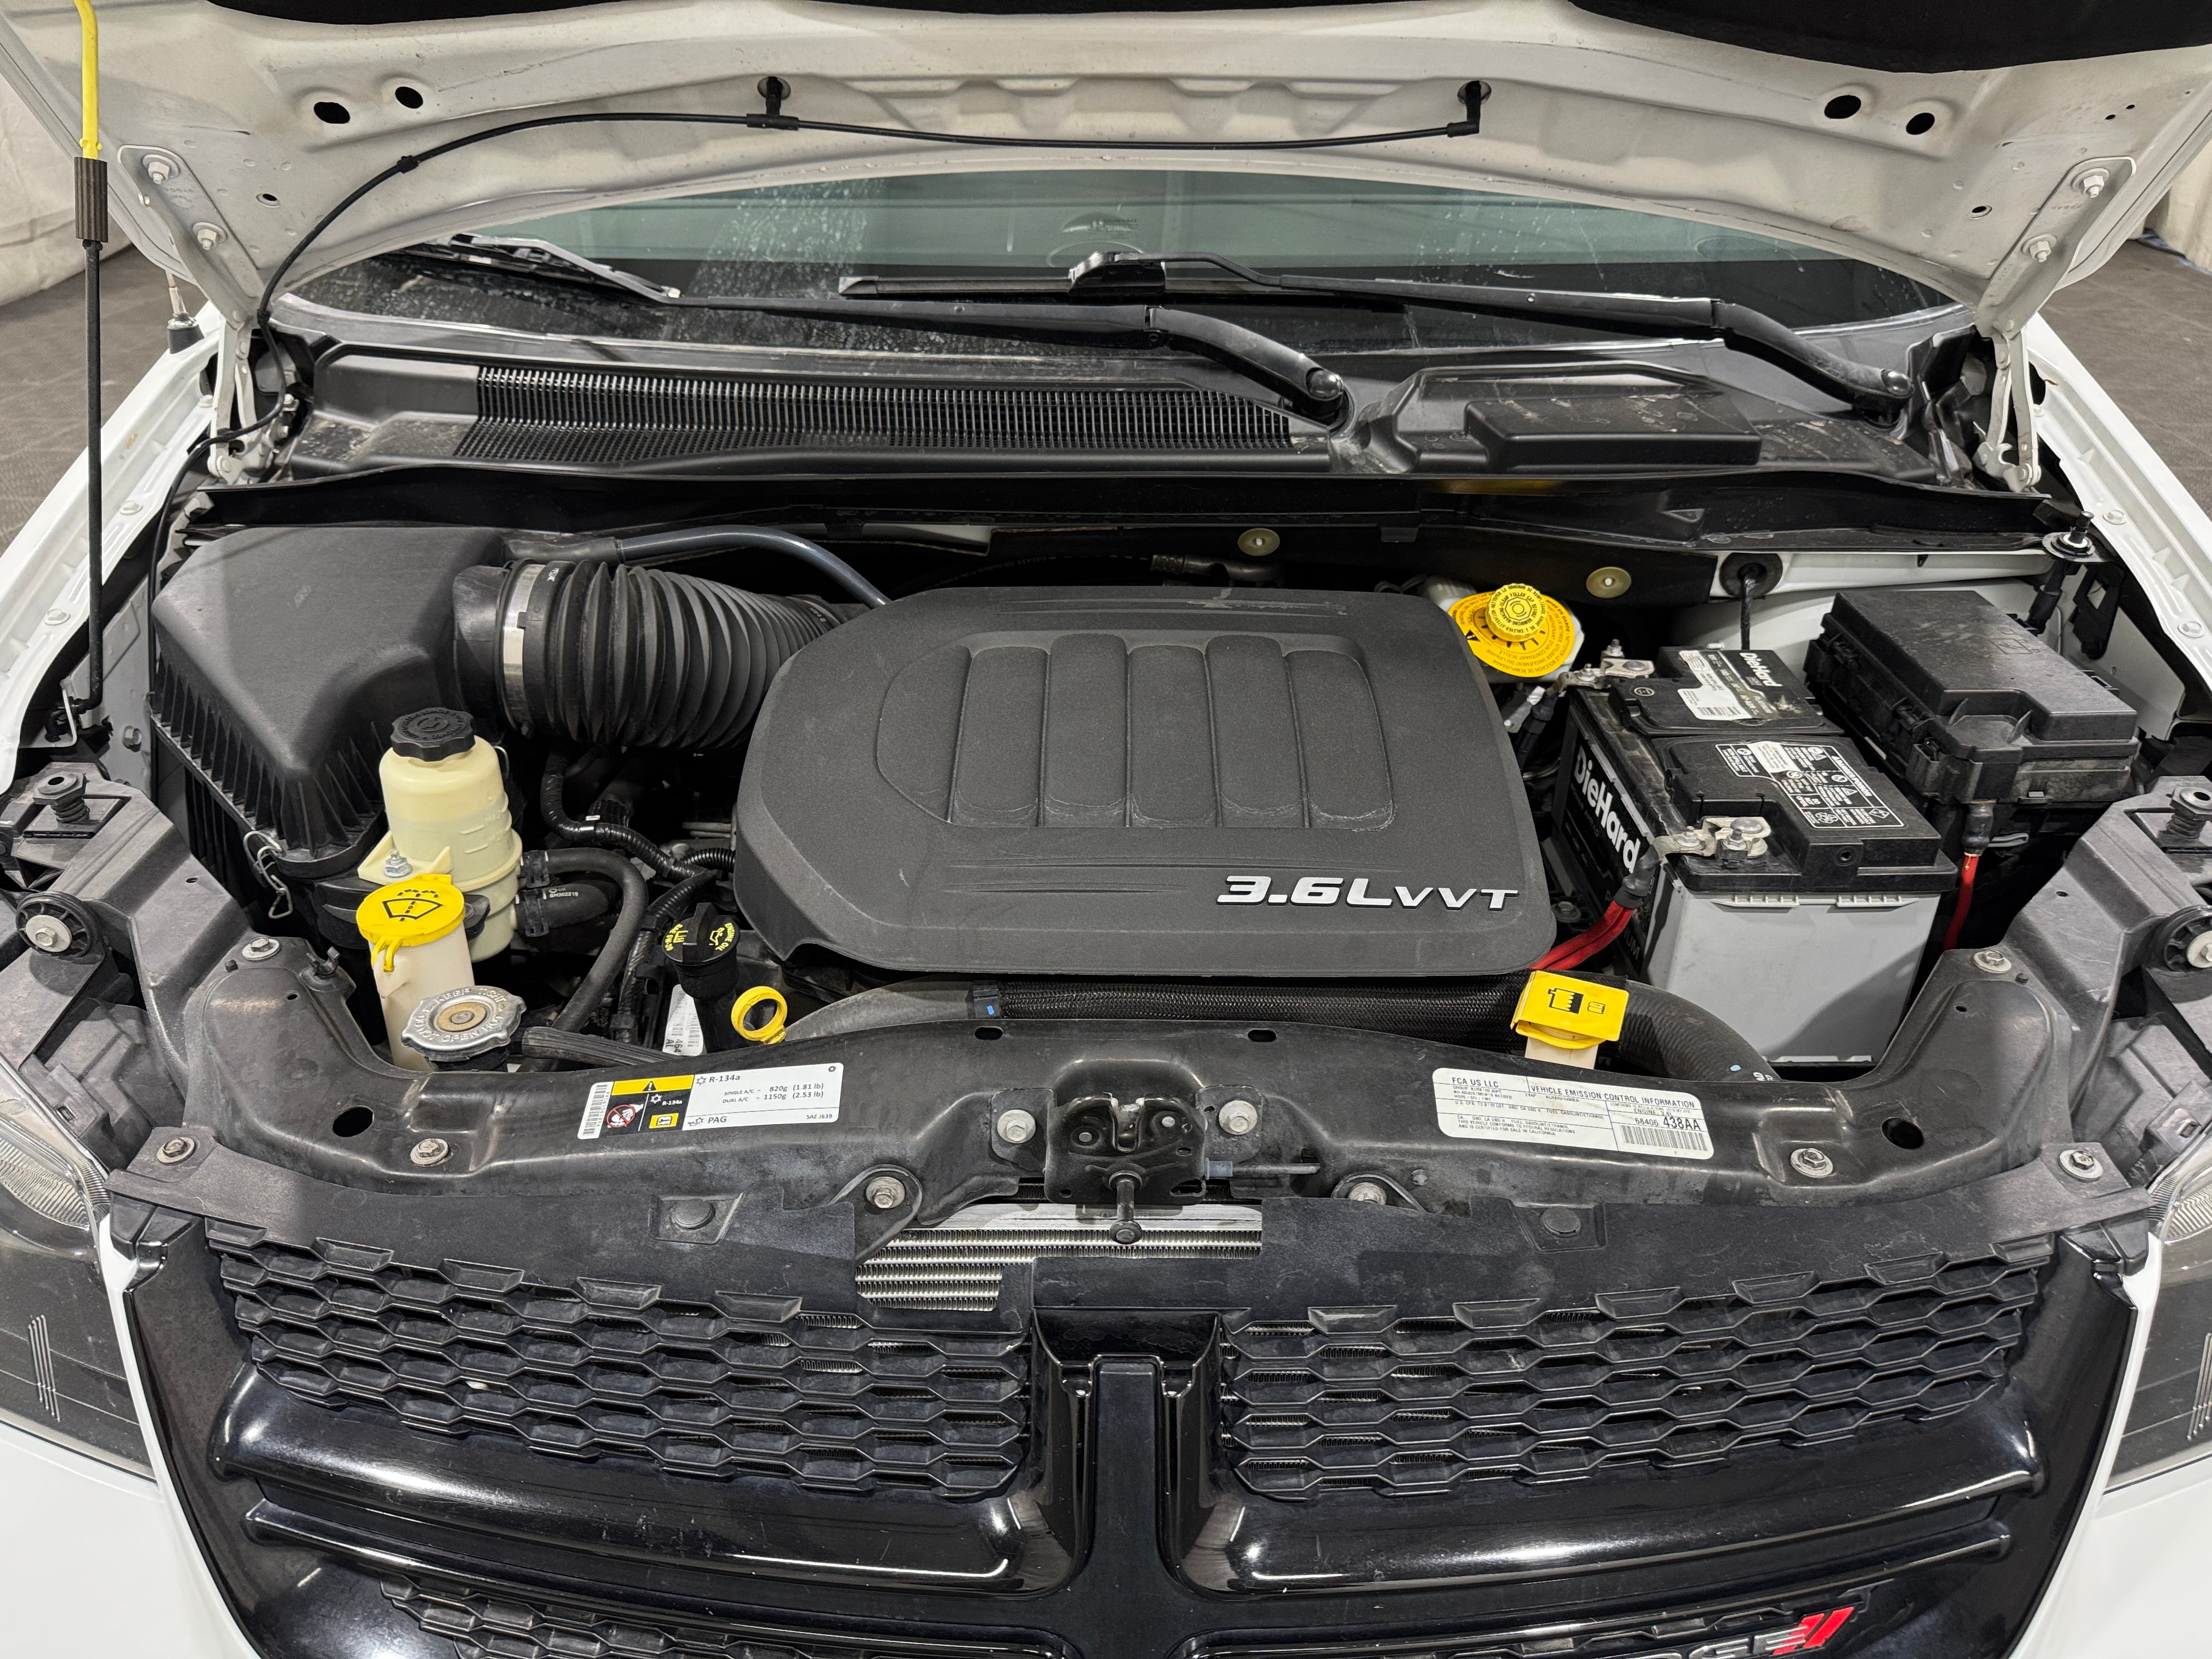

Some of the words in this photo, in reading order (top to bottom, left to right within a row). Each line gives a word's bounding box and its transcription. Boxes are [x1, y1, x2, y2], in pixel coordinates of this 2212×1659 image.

[1739, 652, 1782, 687] DieHard
[1574, 744, 1641, 873] DieHard
[1216, 876, 1392, 908] 3.6L
[1394, 886, 1520, 911] VVT
[669, 923, 683, 934] SAE
[724, 922, 735, 943] ENGINE
[664, 934, 674, 951] 5W-20
[715, 942, 729, 951] OIL
[433, 988, 471, 1004] KEEP
[442, 1031, 481, 1042] OPEN
[665, 1039, 674, 1048] AL
[674, 1039, 683, 1053] 464
[709, 1074, 741, 1083] R-134a
[1531, 1085, 1562, 1095] VEHICLE
[1565, 1089, 1601, 1099] EMISSION
[1604, 1093, 1640, 1103] CONTROL
[1641, 1097, 1695, 1108] INFORMATION
[1635, 1118, 1658, 1126] 68406
[1663, 1116, 1702, 1131] 438AA
